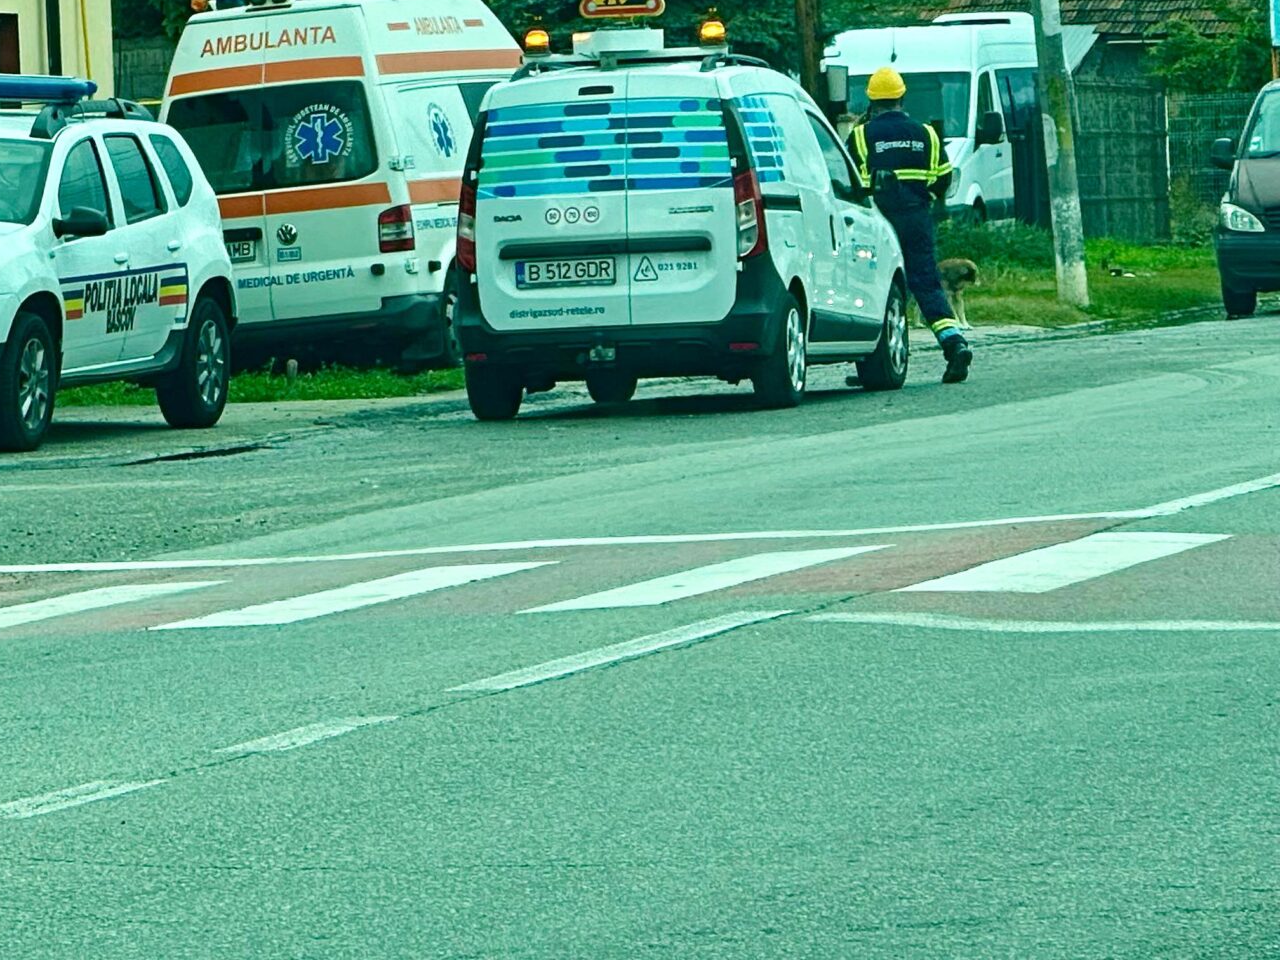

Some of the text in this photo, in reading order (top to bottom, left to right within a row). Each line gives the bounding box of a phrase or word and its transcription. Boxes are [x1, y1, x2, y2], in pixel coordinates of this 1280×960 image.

[200, 26, 336, 58] AMBULANTA
[528, 260, 610, 281] B 512 GDR
[657, 263, 674, 272] 021
[237, 276, 284, 290] MEDICAL
[286, 273, 301, 286] DE
